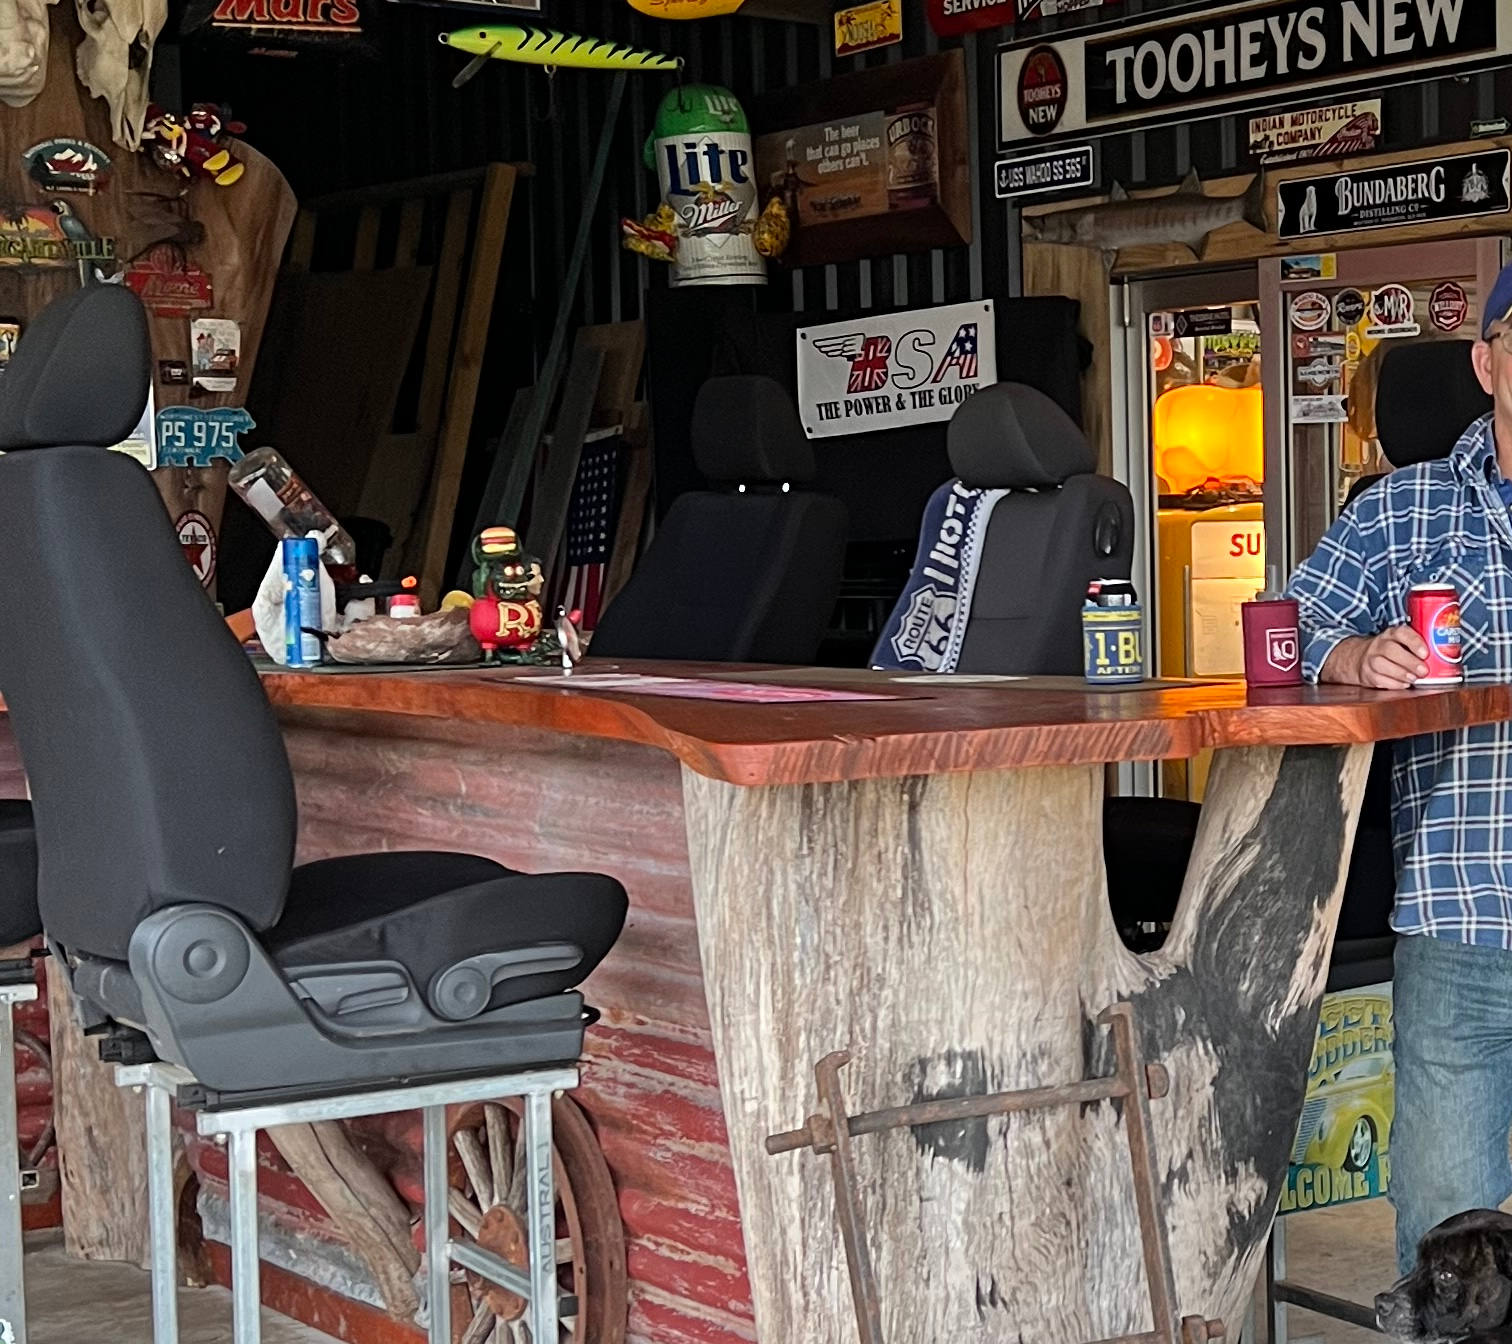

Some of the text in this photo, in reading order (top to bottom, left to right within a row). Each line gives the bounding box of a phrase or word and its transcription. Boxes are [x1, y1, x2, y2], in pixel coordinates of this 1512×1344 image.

[1106, 7, 1328, 104] TOOHEYS
[1024, 84, 1061, 103] TOOHEYS
[1029, 104, 1057, 124] NEW
[1251, 103, 1358, 135] INDIAN MOTORCYCLE
[1276, 126, 1323, 147] COMPANY
[665, 142, 748, 196] Lite
[1335, 166, 1445, 216] BUNDABERG
[682, 200, 743, 229] Miller
[847, 323, 977, 394] BSA
[816, 389, 936, 421] THE POWER & THE
[162, 421, 234, 448] PS 975
[903, 595, 934, 650] ROUTE
